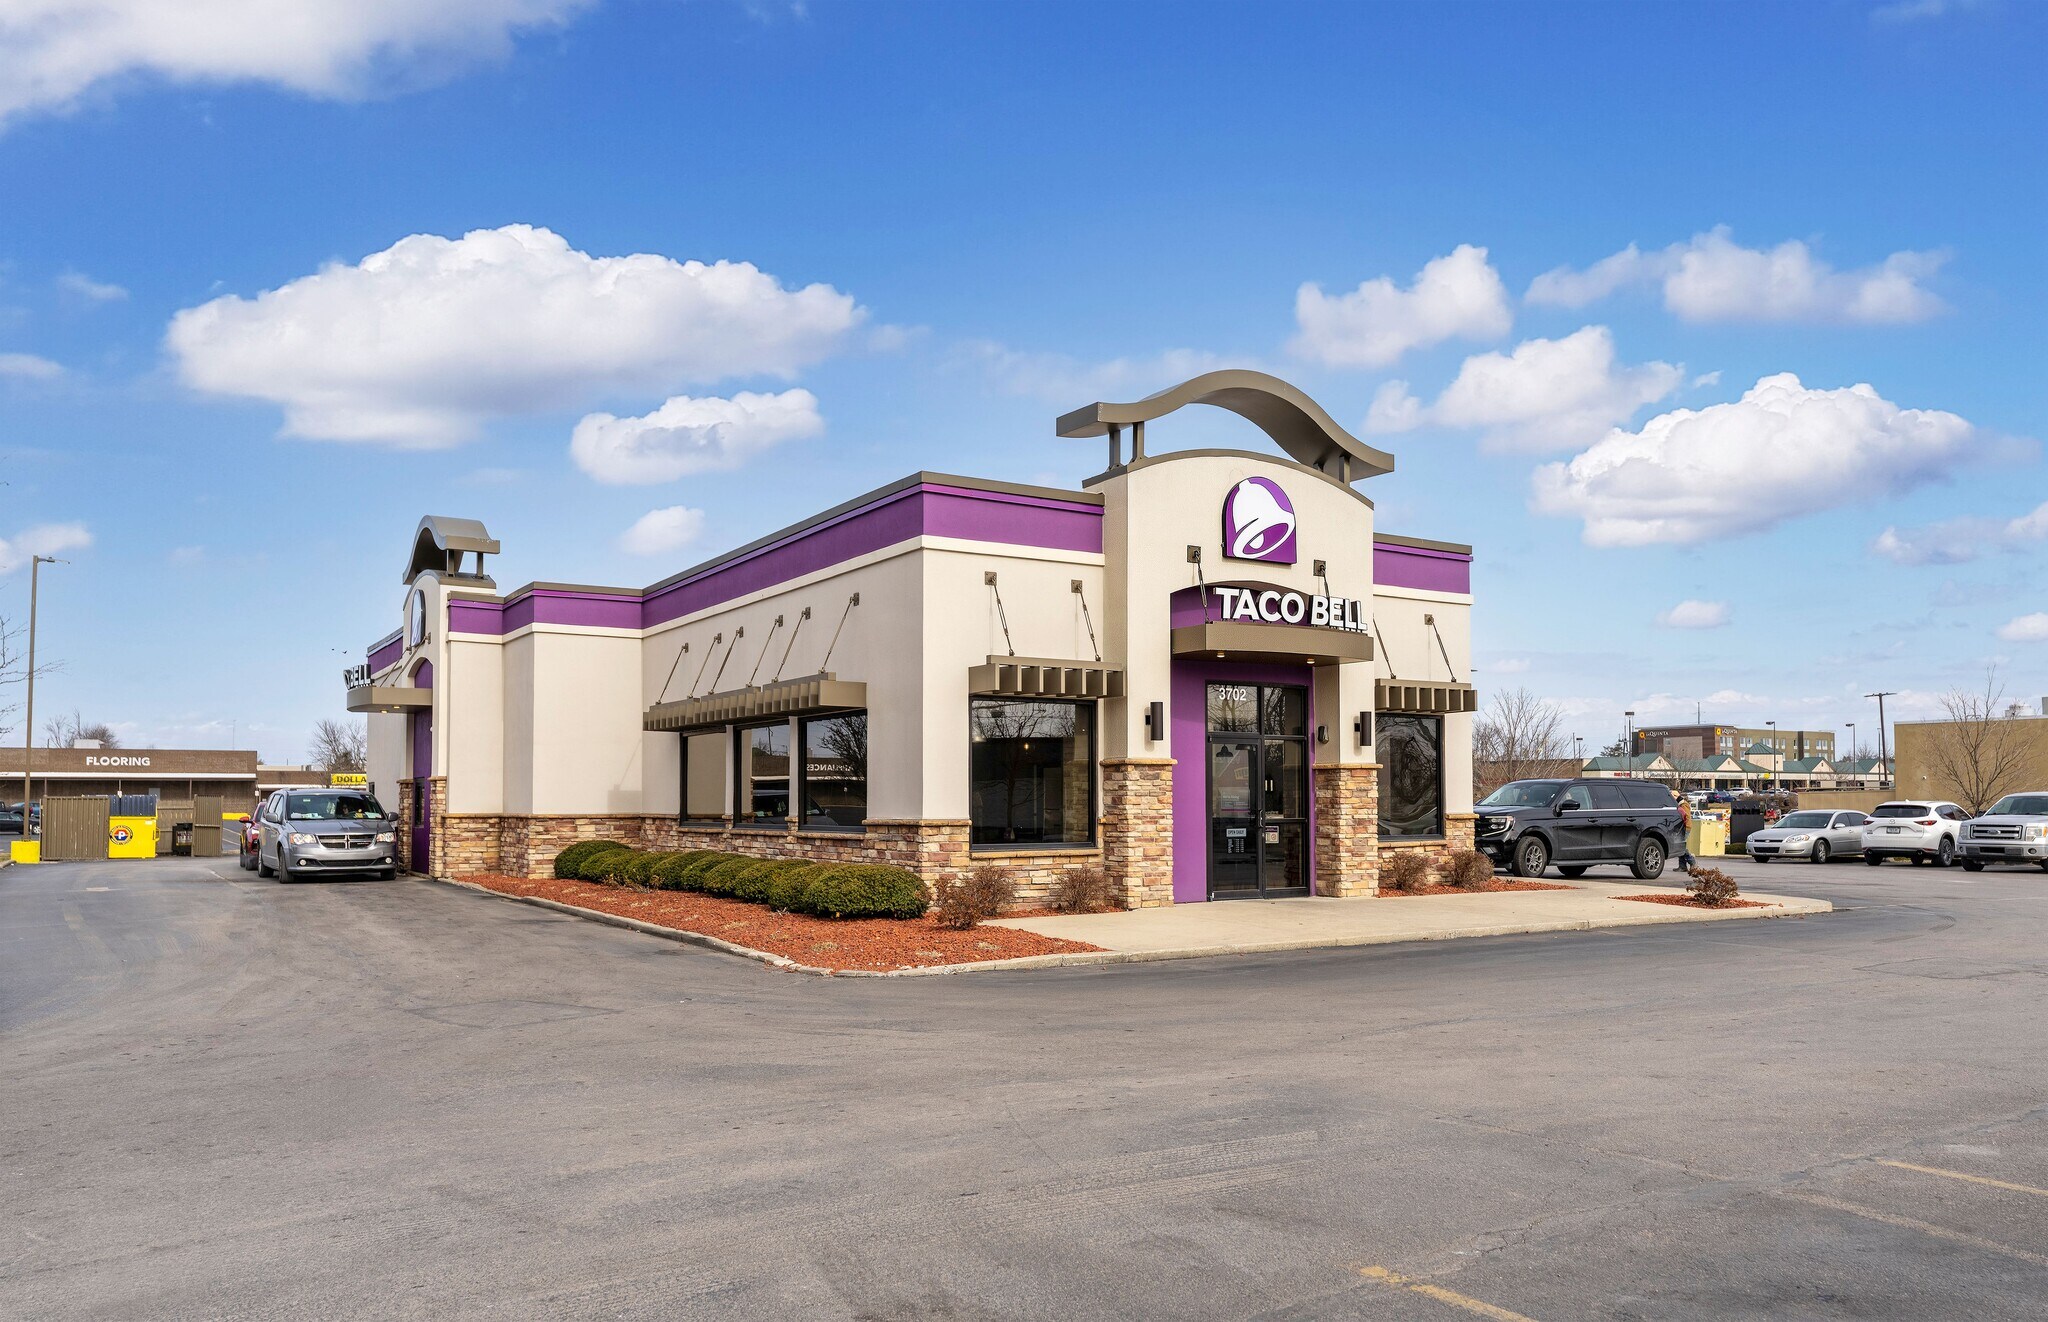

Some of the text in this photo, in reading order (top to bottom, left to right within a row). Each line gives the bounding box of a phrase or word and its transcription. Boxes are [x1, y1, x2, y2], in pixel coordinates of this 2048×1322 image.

[1213, 587, 1368, 631] TACO BELL
[1218, 687, 1247, 701] 3702
[86, 756, 151, 766] FLOORING
